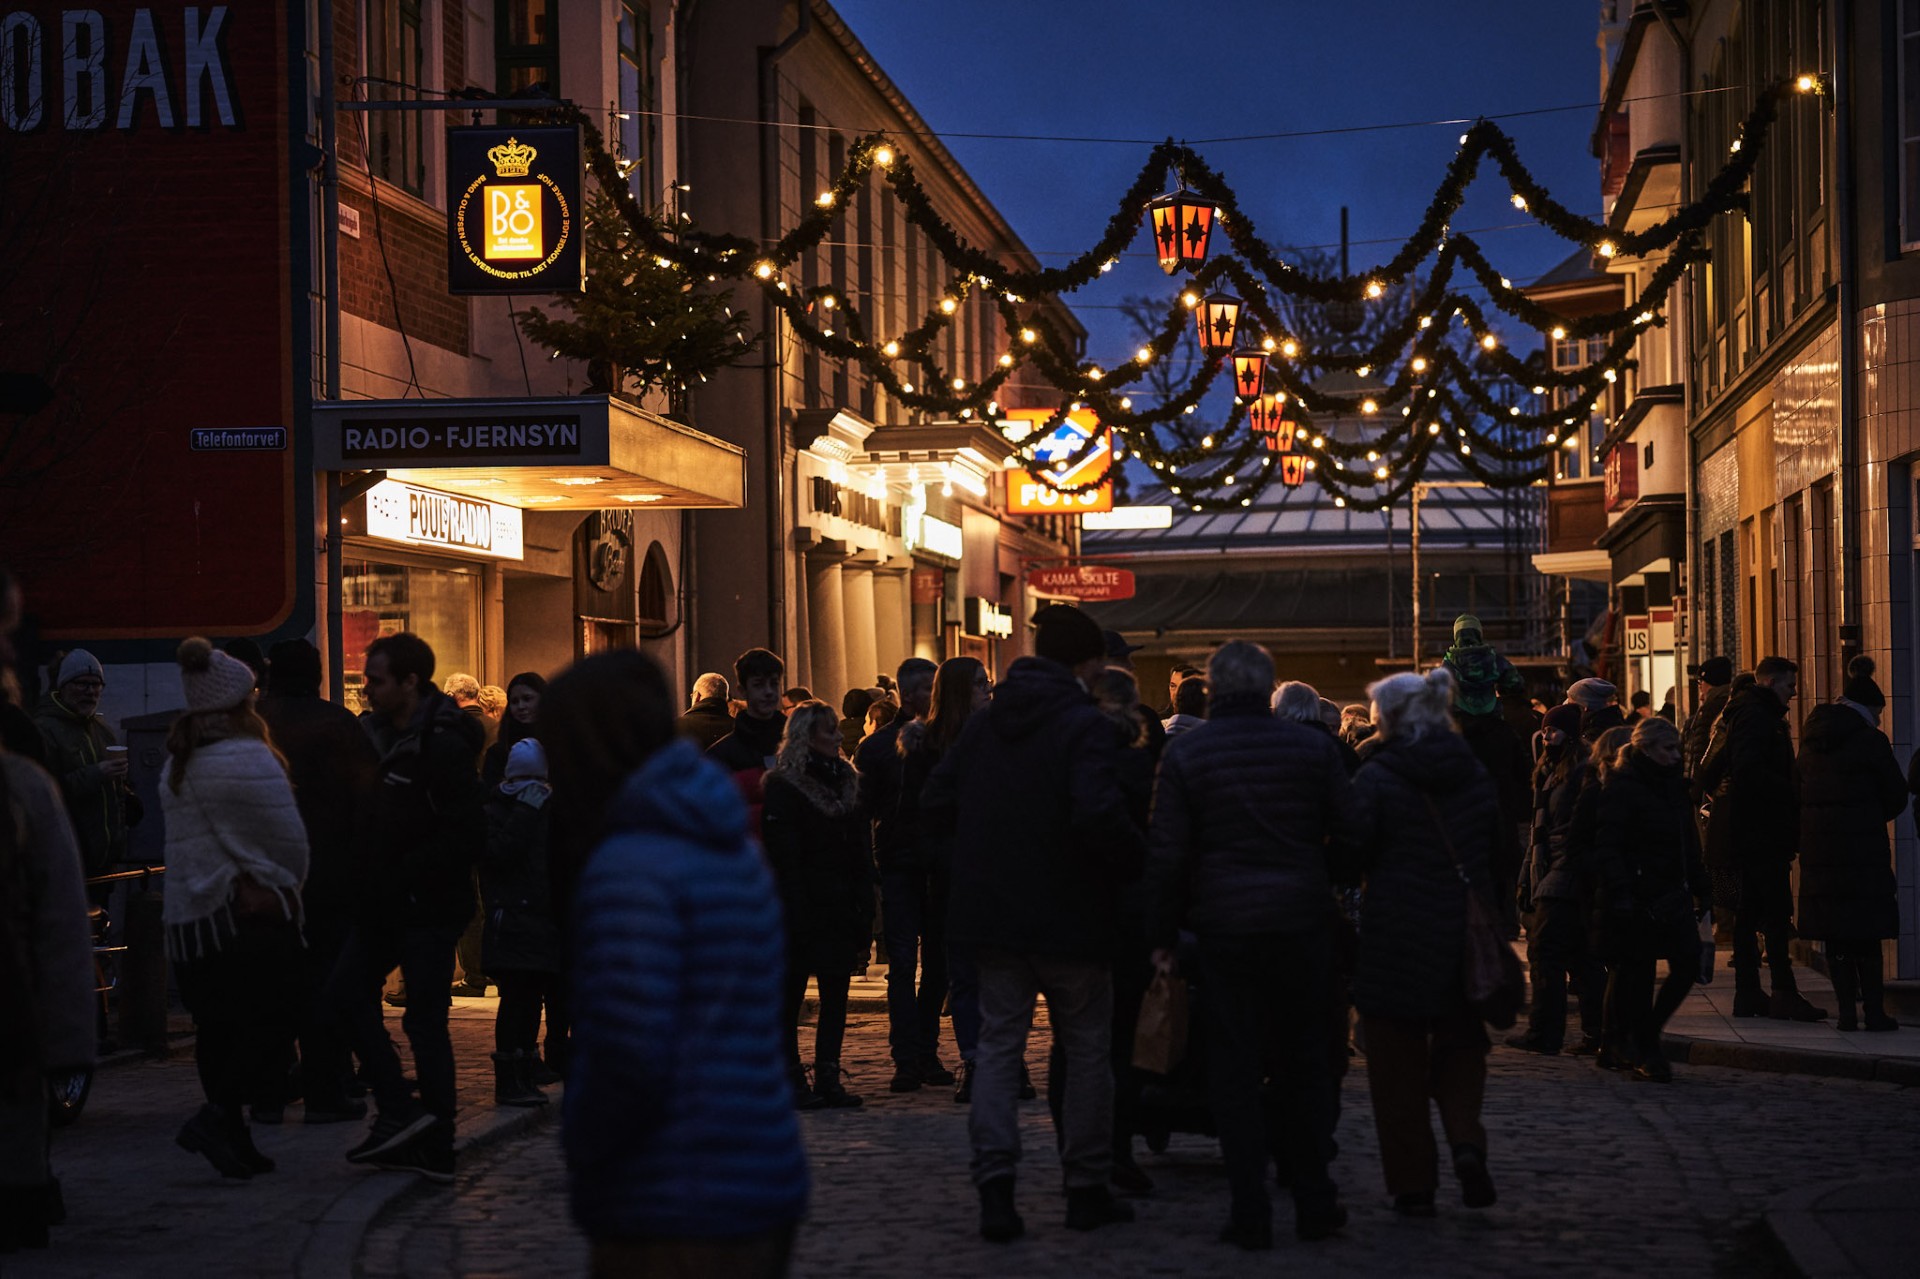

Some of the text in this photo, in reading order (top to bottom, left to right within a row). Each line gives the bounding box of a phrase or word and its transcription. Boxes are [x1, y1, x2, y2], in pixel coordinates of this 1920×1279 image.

[0, 5, 236, 133] OBAK
[468, 174, 487, 193] BANG
[537, 173, 554, 187] HOF
[551, 184, 570, 218] DANSKE
[457, 200, 470, 239] OLUFSEN
[547, 219, 571, 265] KONGELIGE
[468, 253, 519, 280] LEVERANDØR
[519, 270, 533, 279] TIL
[532, 261, 548, 275] DET
[196, 431, 280, 448] Telefontorvet
[450, 500, 491, 548] RADIO
[1042, 572, 1120, 586] KAMA SKILTE
